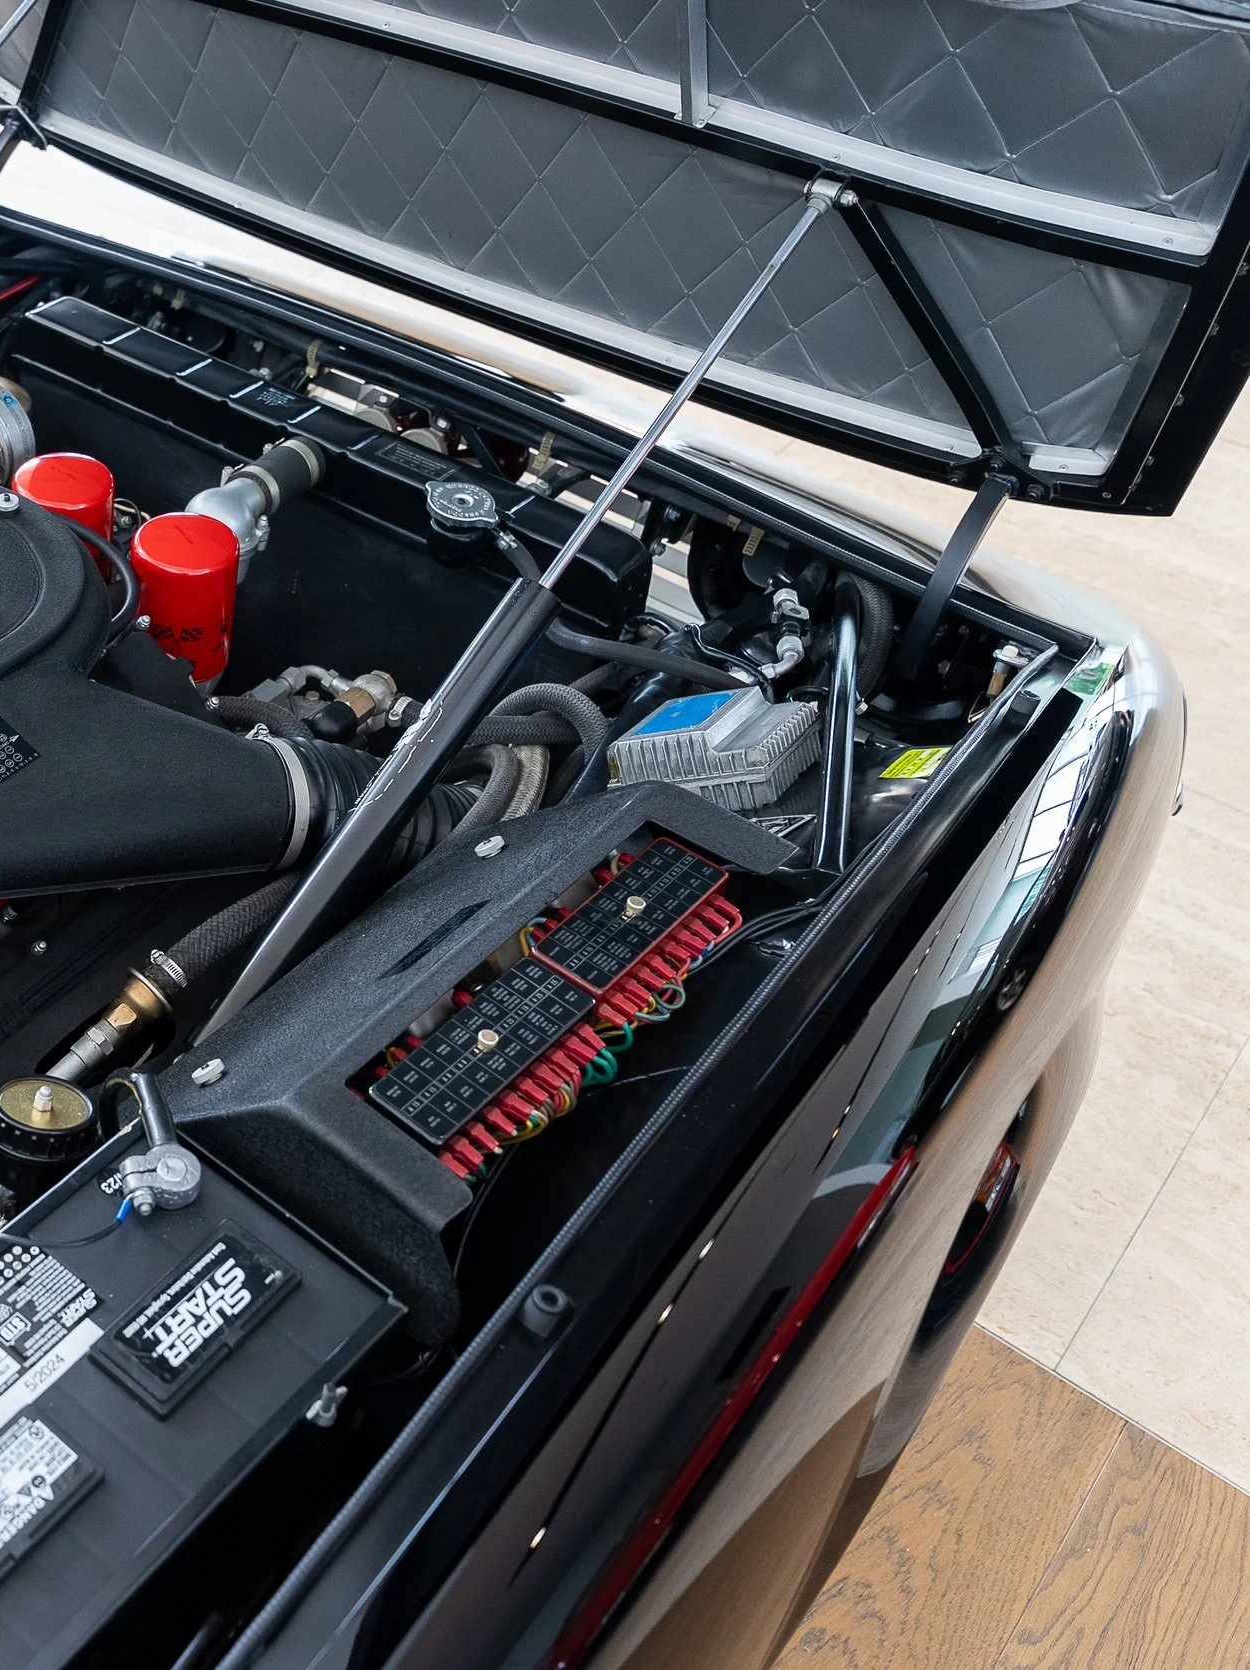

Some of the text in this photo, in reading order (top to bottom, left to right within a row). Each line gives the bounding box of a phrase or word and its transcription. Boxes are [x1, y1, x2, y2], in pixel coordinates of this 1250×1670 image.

[55, 1287, 96, 1323] START
[62, 1297, 98, 1328] SUPER
[142, 1256, 248, 1355] START
[160, 1280, 255, 1368] SUPER
[24, 1353, 66, 1393] 5/2024
